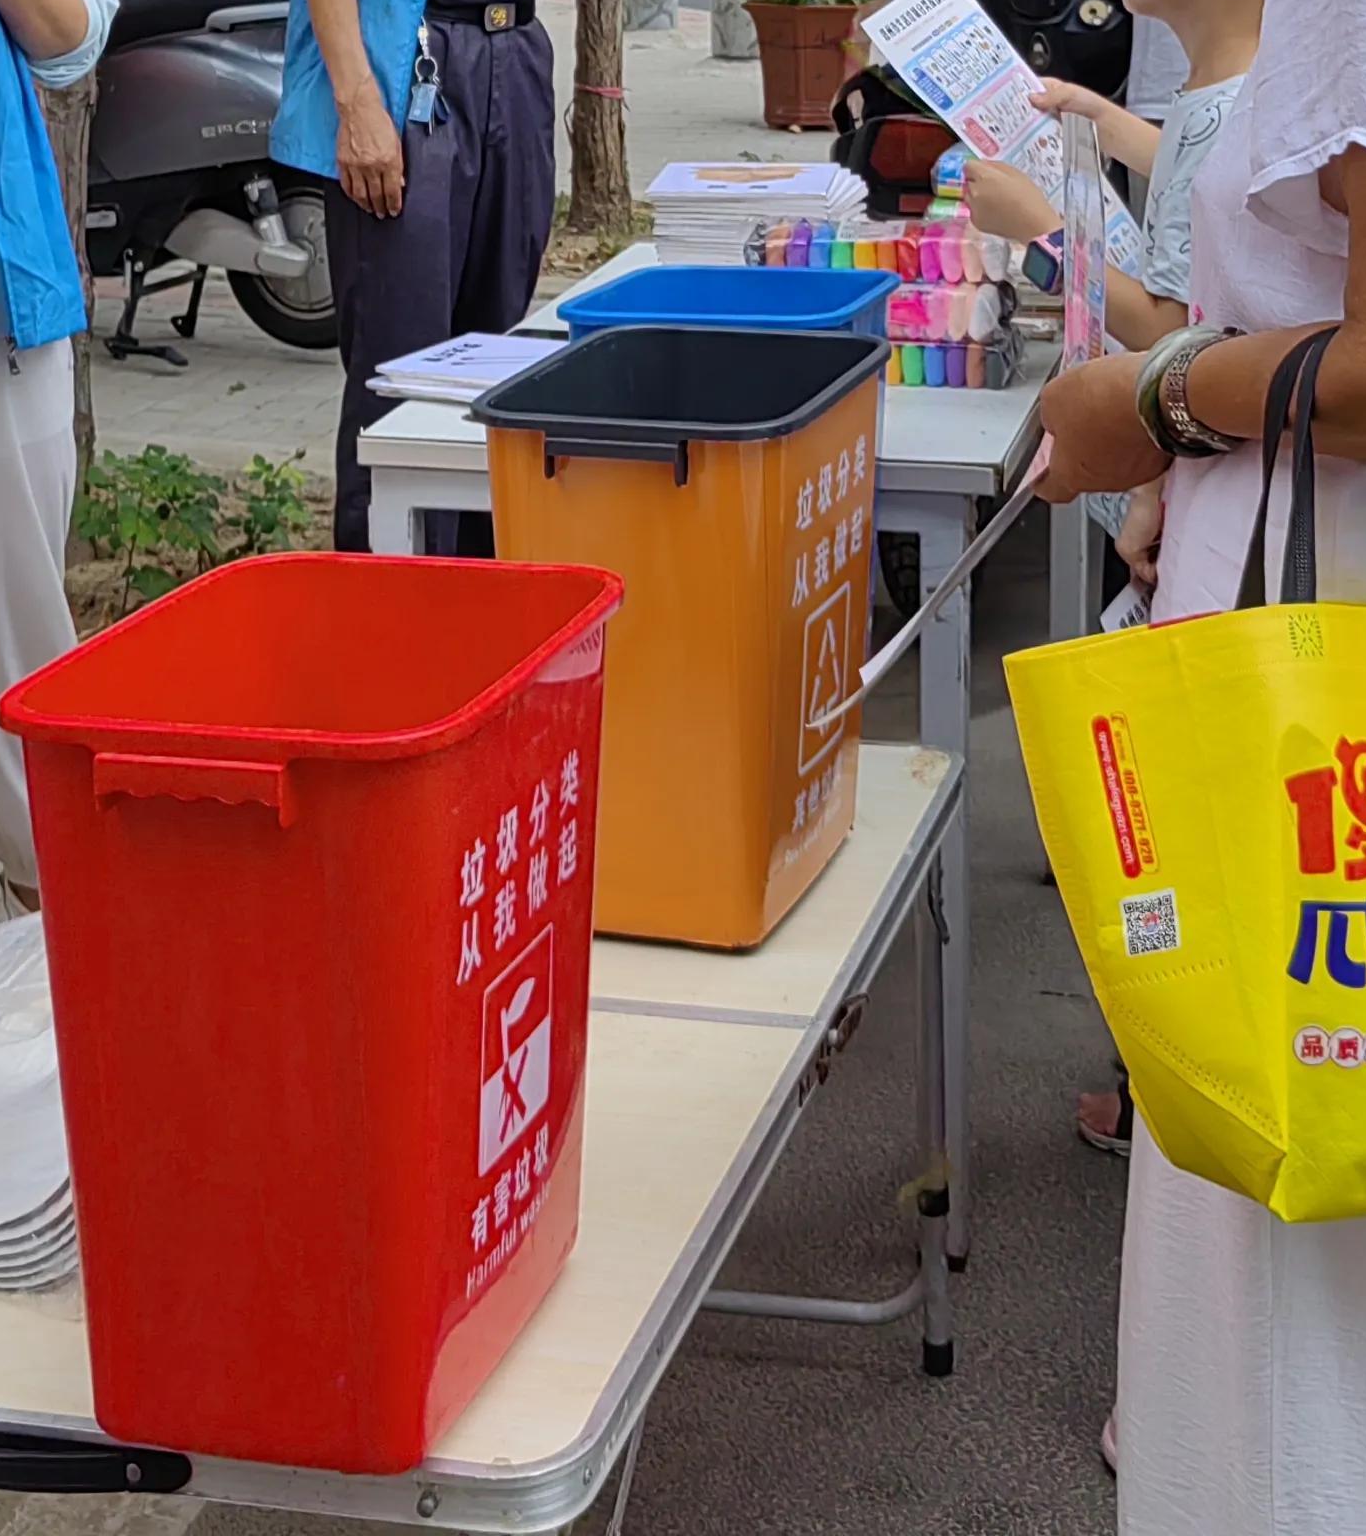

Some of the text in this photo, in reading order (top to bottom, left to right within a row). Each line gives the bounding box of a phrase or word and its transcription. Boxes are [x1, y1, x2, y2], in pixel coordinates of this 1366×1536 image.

[796, 435, 866, 531] 垃圾分类
[792, 510, 865, 607] 从我做起
[459, 749, 579, 909] 垃圾分类
[456, 826, 578, 985] 从我做起
[471, 1120, 549, 1253] 有害垃圾
[466, 1216, 517, 1301] Harmful
